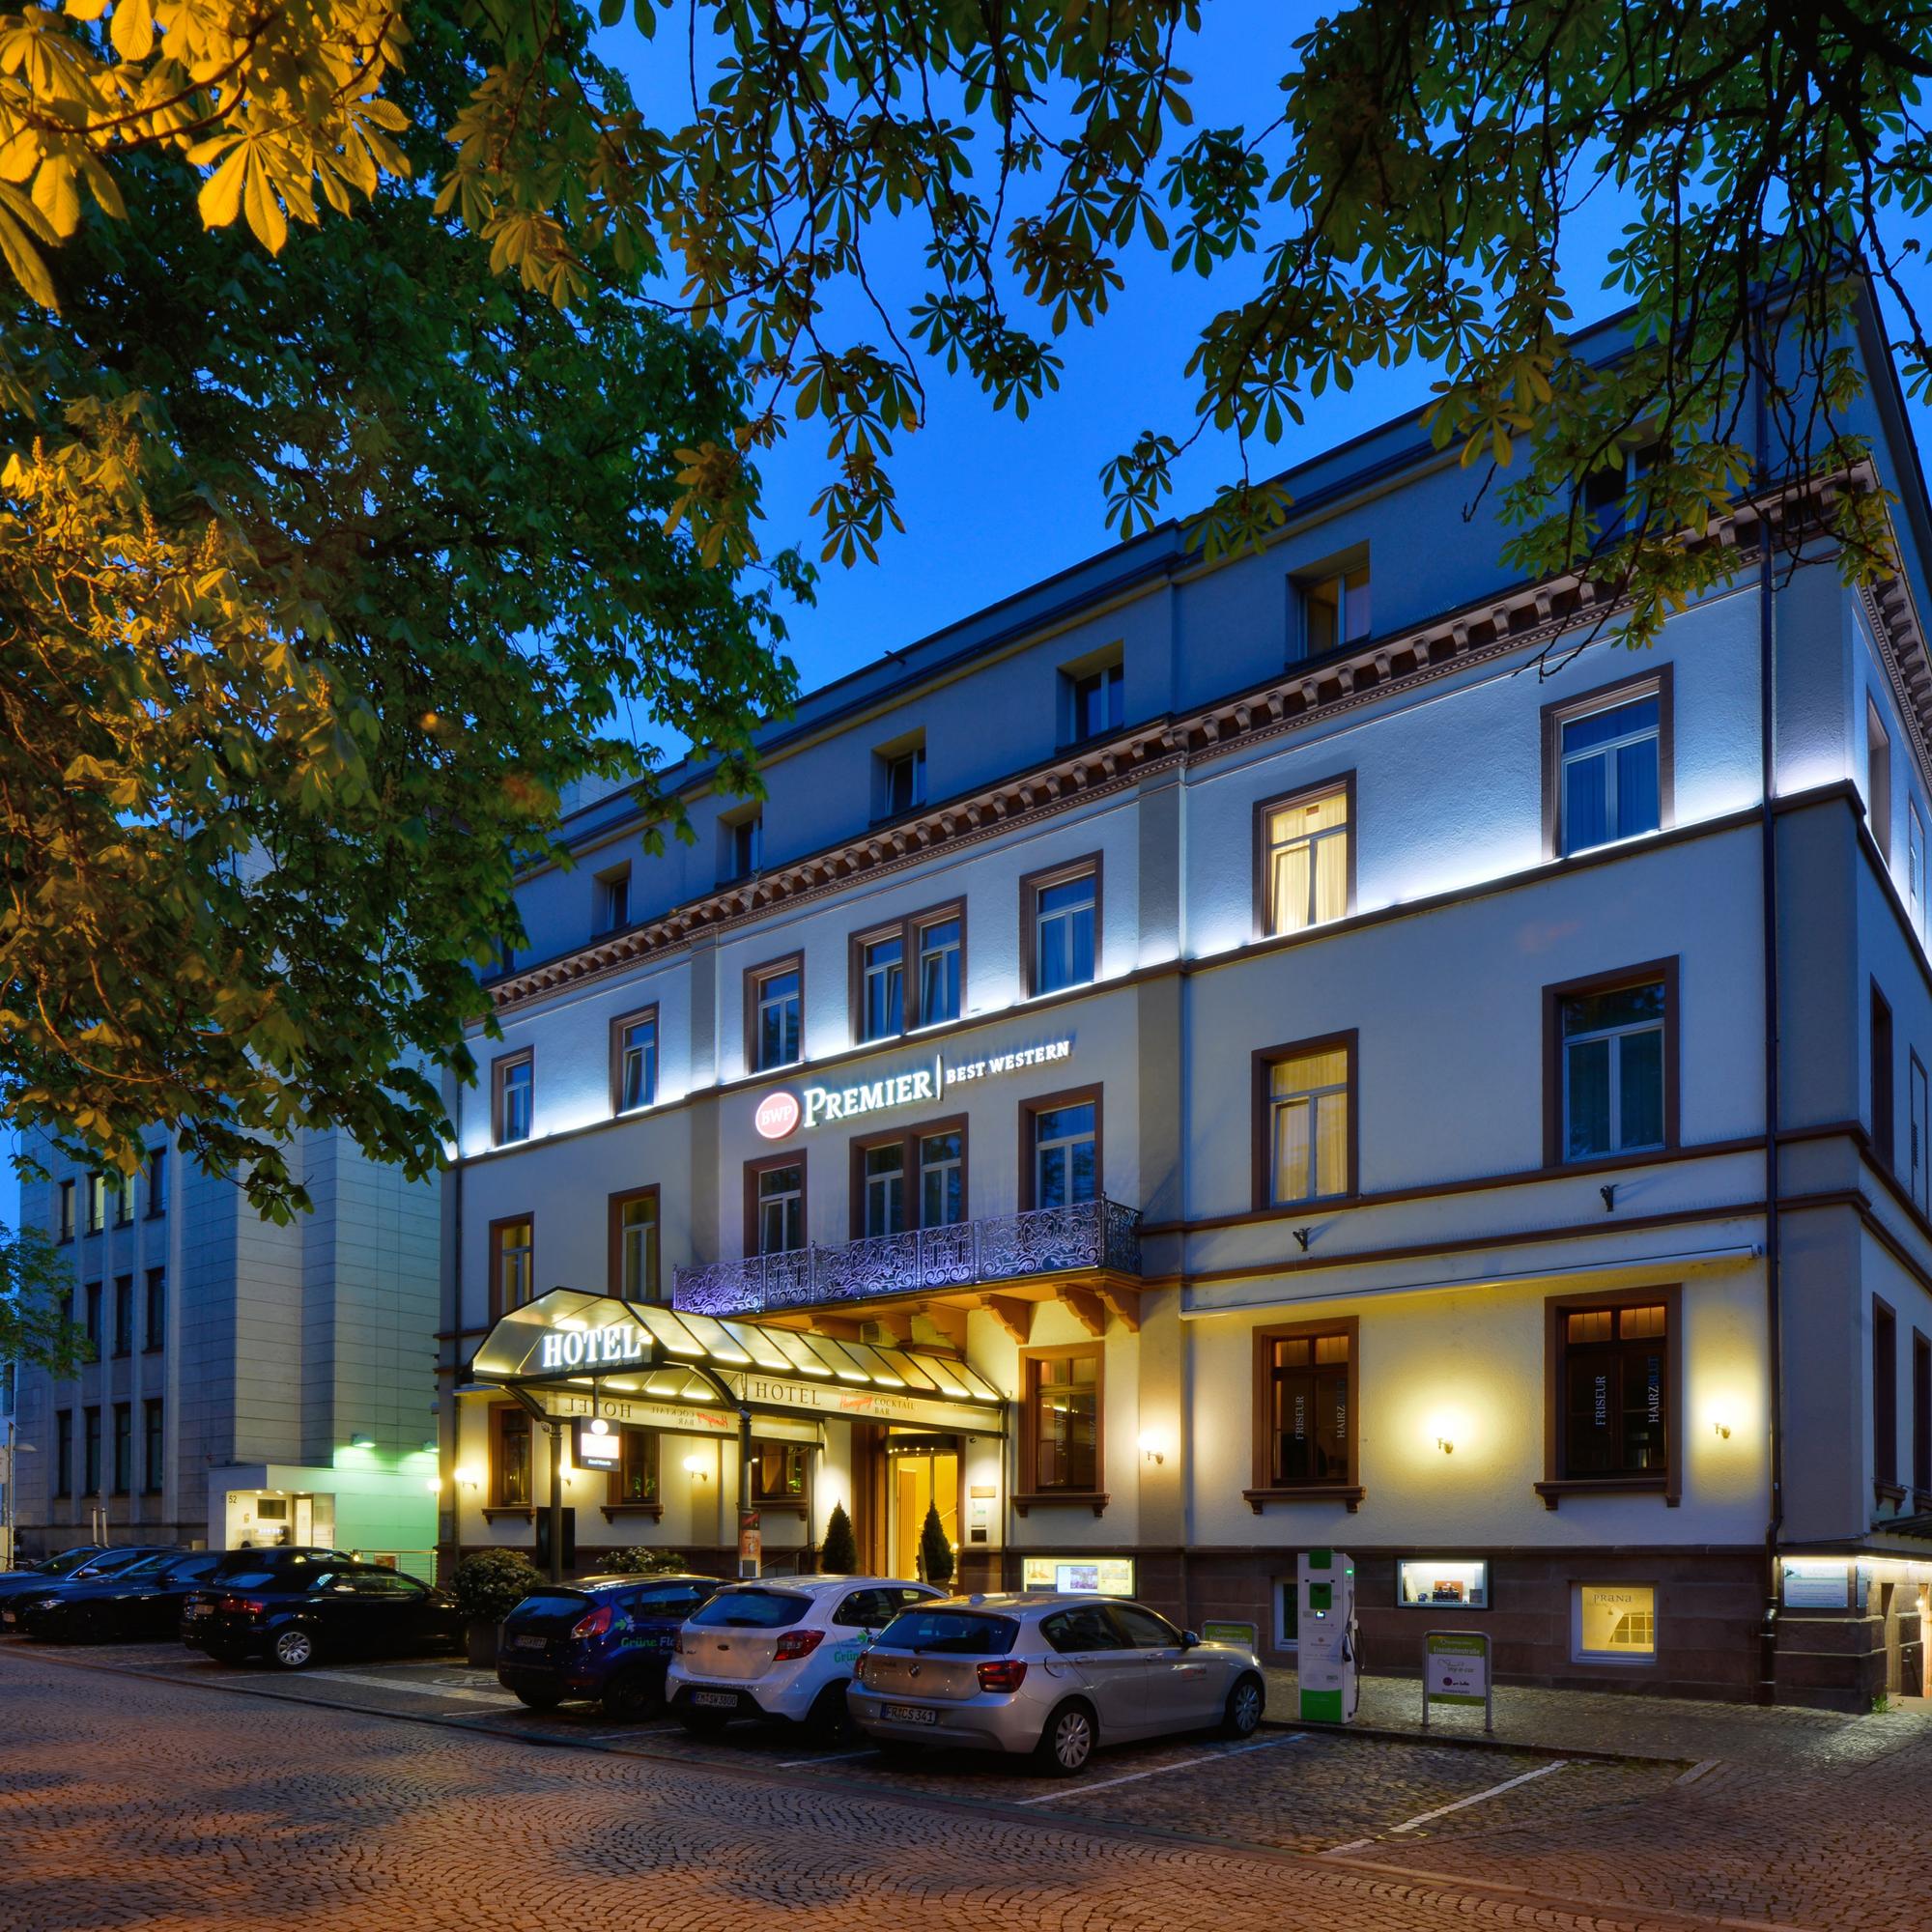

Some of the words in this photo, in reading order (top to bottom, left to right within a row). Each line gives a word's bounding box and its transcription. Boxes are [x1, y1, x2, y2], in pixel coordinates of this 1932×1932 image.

[946, 1063, 986, 1085] BEST
[989, 1040, 1070, 1073] WESTERN
[761, 1105, 793, 1126] BWP
[803, 1069, 933, 1128] PREMIER
[542, 1324, 641, 1368] HOTEL
[754, 1381, 821, 1406] HOTEL
[874, 1397, 915, 1410] COCKTAIL
[874, 1406, 891, 1415] BAR
[1595, 1376, 1606, 1426] FRISEUR
[1294, 1395, 1304, 1440] FRISEUR
[621, 1636, 658, 1647] Grüne
[888, 1706, 897, 1718] FR
[915, 1710, 933, 1722] 341
